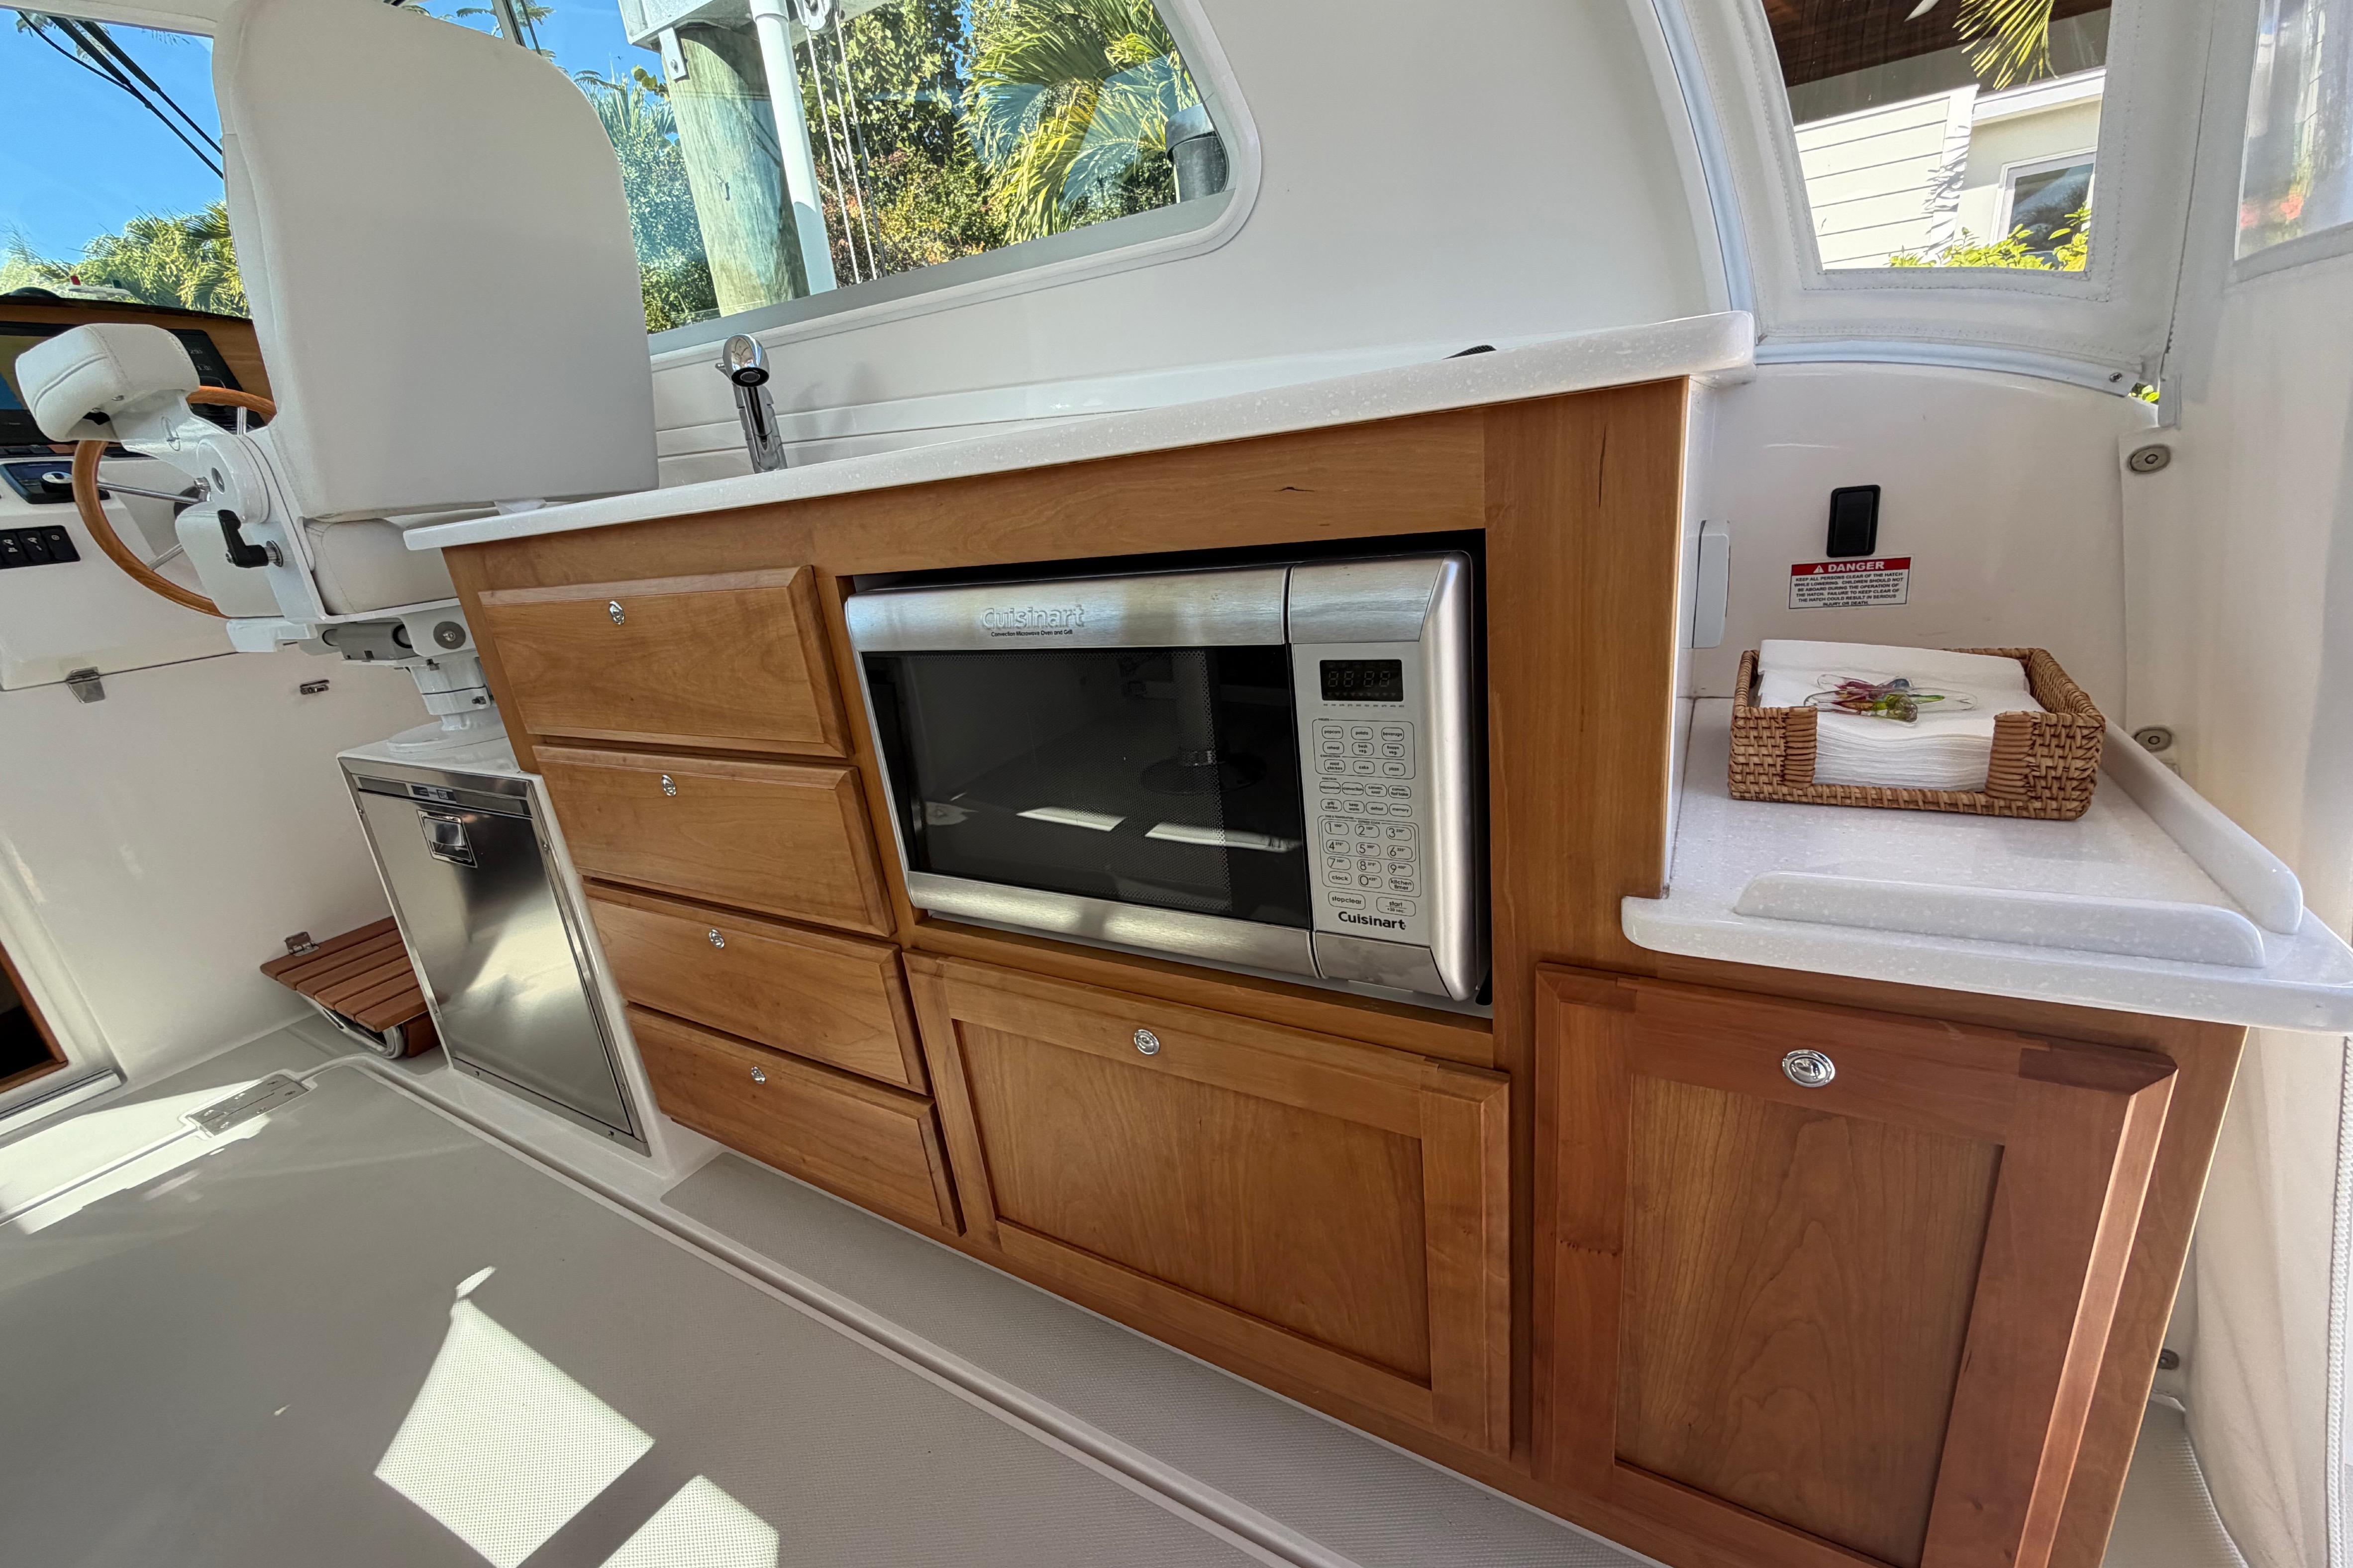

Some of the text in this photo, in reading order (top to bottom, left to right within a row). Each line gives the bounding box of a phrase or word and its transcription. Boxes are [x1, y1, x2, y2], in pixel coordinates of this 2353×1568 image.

[1828, 561, 1884, 572] DANGER
[981, 604, 1084, 630] Cuisinart
[1329, 823, 1331, 832] 1
[1358, 825, 1365, 835] 2
[1389, 828, 1395, 838] 3
[1329, 842, 1334, 850] 4
[1359, 844, 1365, 854] 5
[1390, 847, 1396, 856] 6
[1330, 858, 1335, 868] 7
[1360, 861, 1367, 871] 8
[1390, 864, 1397, 873] 9
[1338, 911, 1406, 930] Cuisinart
